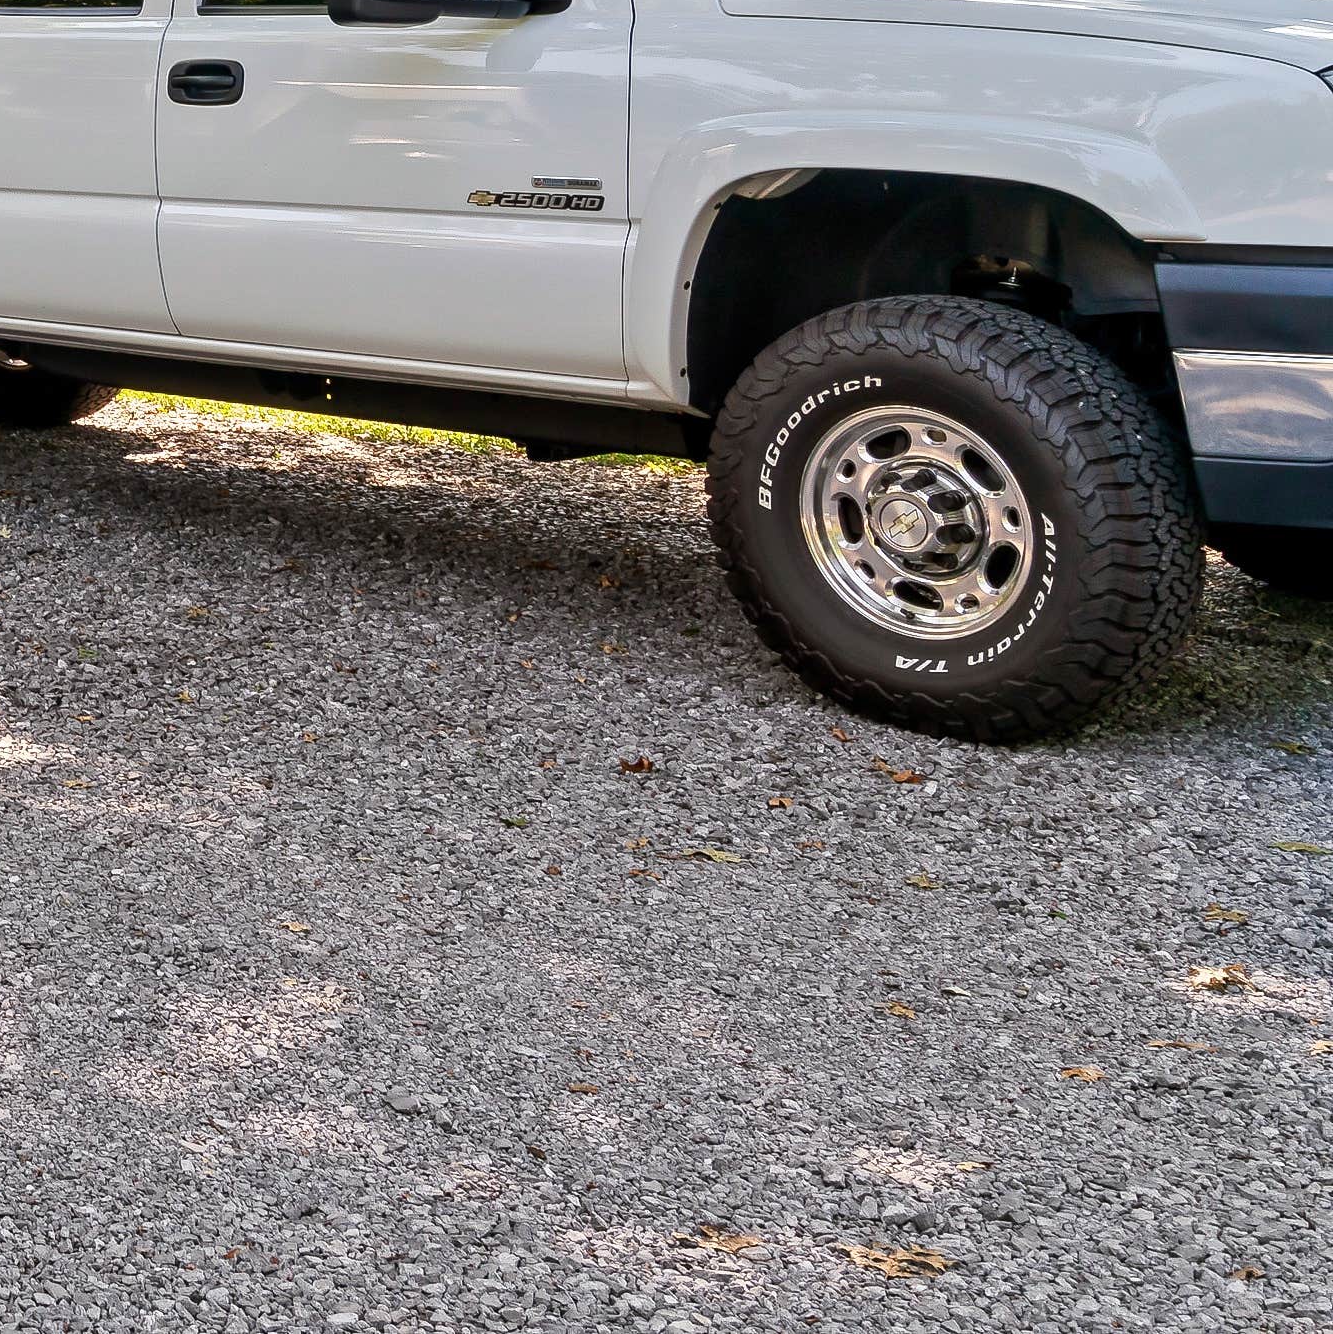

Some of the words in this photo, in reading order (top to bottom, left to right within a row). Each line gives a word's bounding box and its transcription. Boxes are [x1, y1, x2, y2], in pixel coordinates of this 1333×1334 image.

[499, 192, 568, 208] 2500
[570, 195, 602, 210] HD
[758, 375, 882, 511] BFGoodrich
[967, 512, 1057, 666] All-Terrain
[895, 654, 950, 673] T/A
